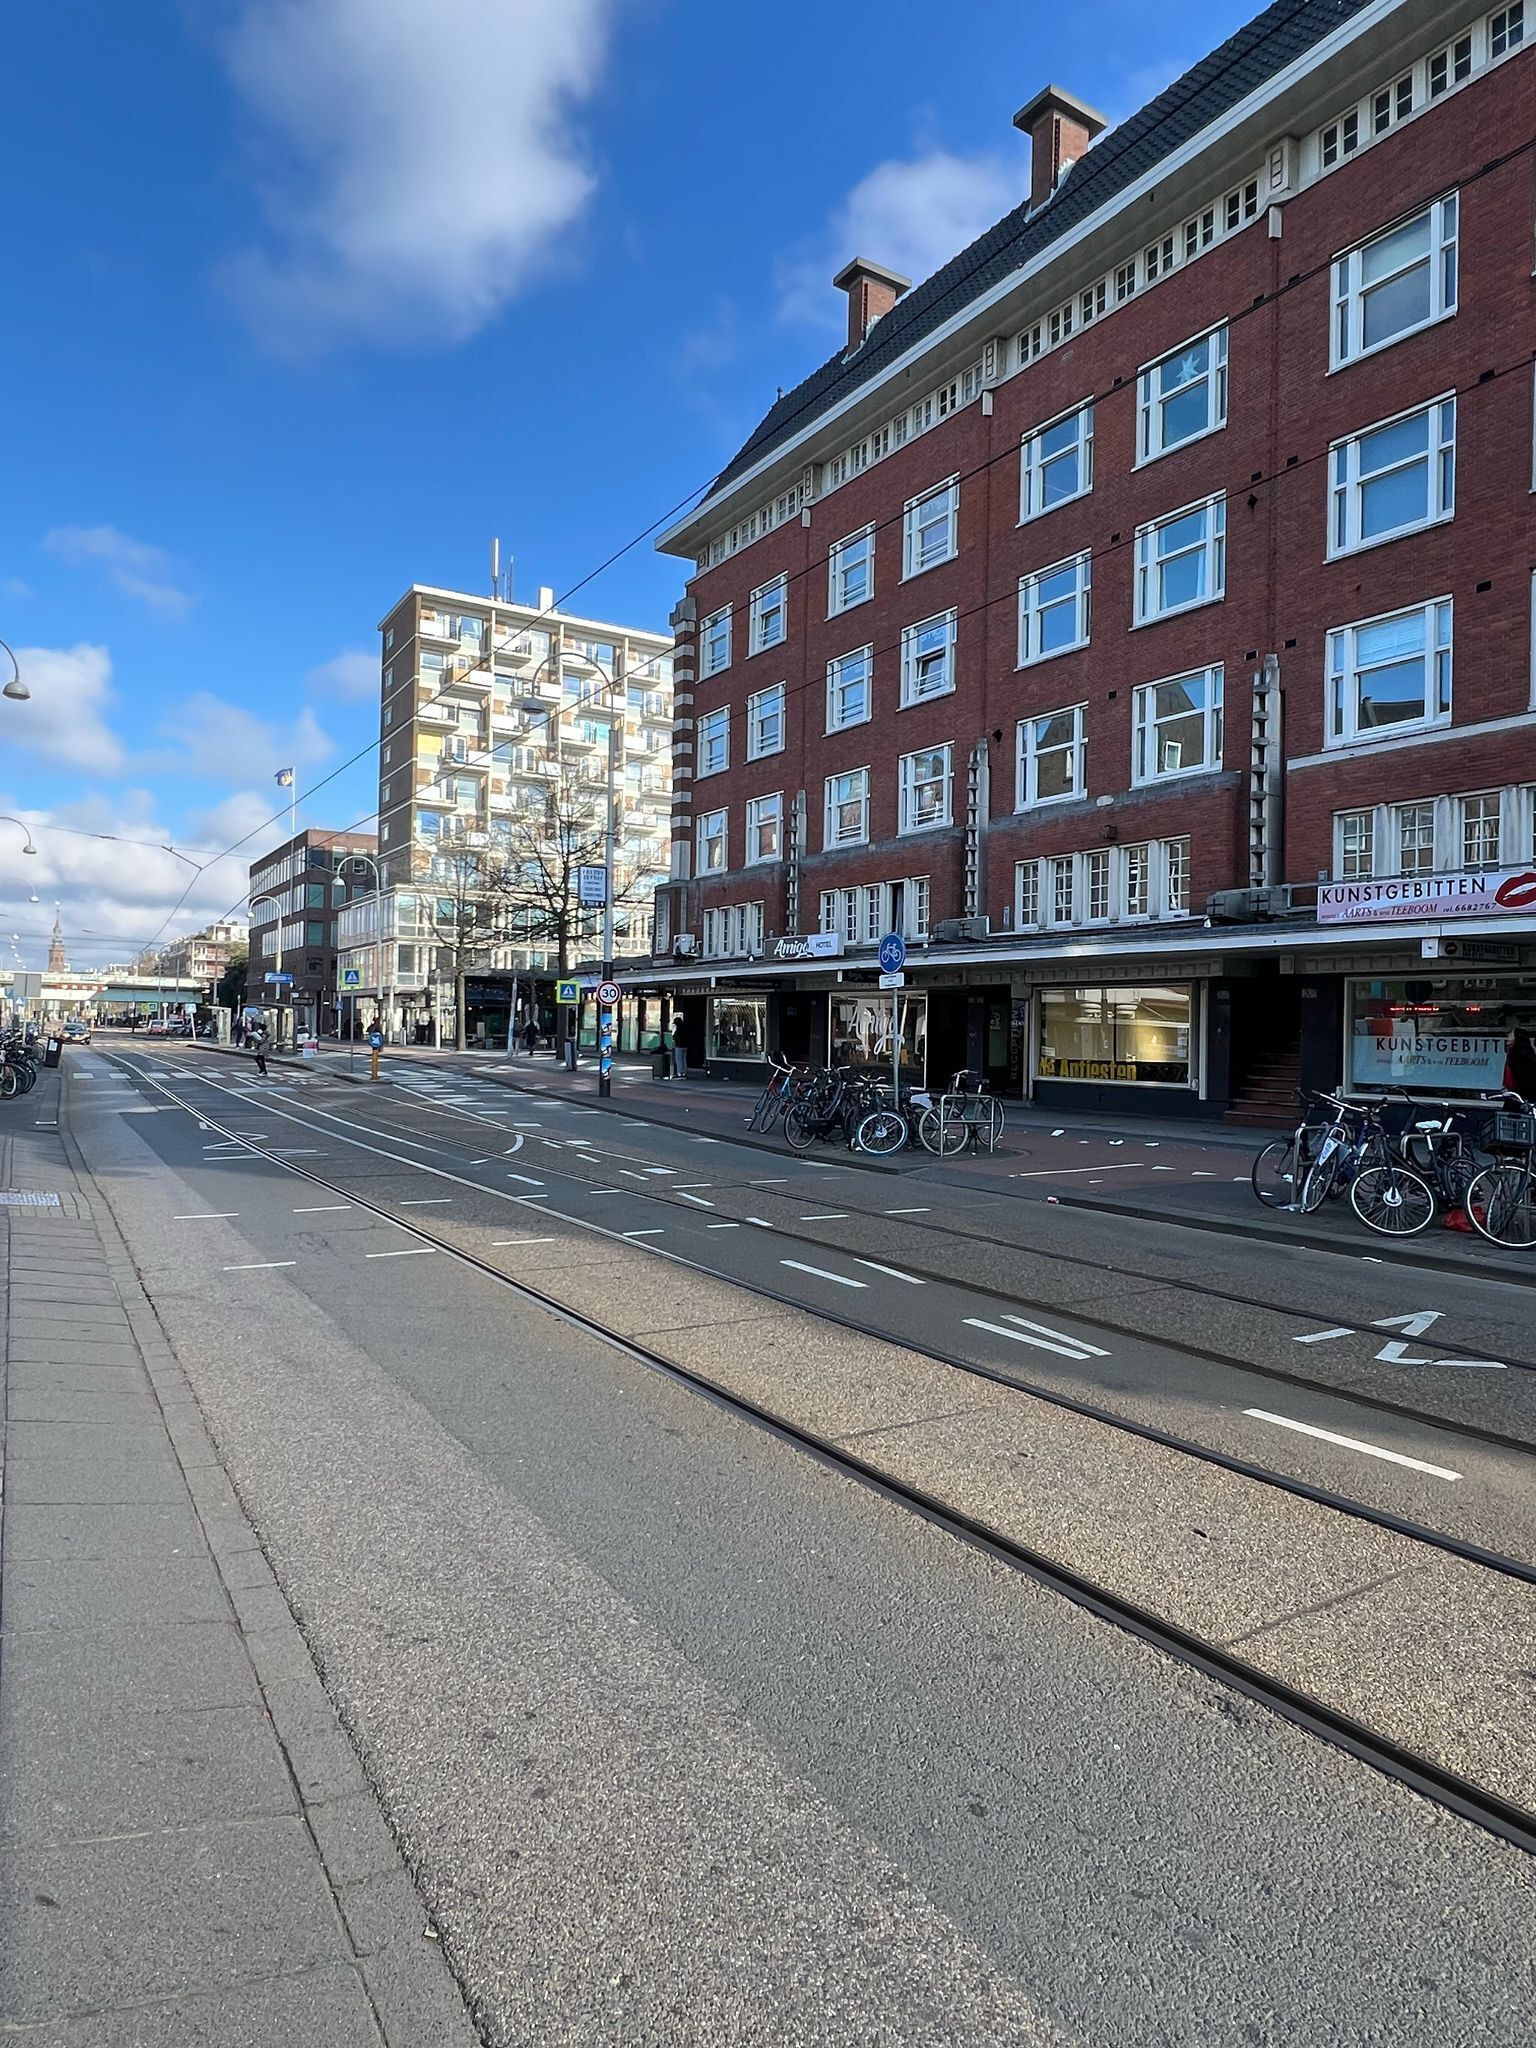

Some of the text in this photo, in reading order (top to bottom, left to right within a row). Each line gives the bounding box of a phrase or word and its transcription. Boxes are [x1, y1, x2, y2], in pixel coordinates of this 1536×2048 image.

[1321, 877, 1486, 904] KUNSTGEBITTEN
[1342, 907, 1372, 918] AARTS
[1391, 903, 1438, 915] TEEBOOM
[774, 939, 832, 958] Amigo HOTEL
[602, 989, 616, 998] 30
[1376, 1037, 1509, 1053] KUNSTGEBITTE
